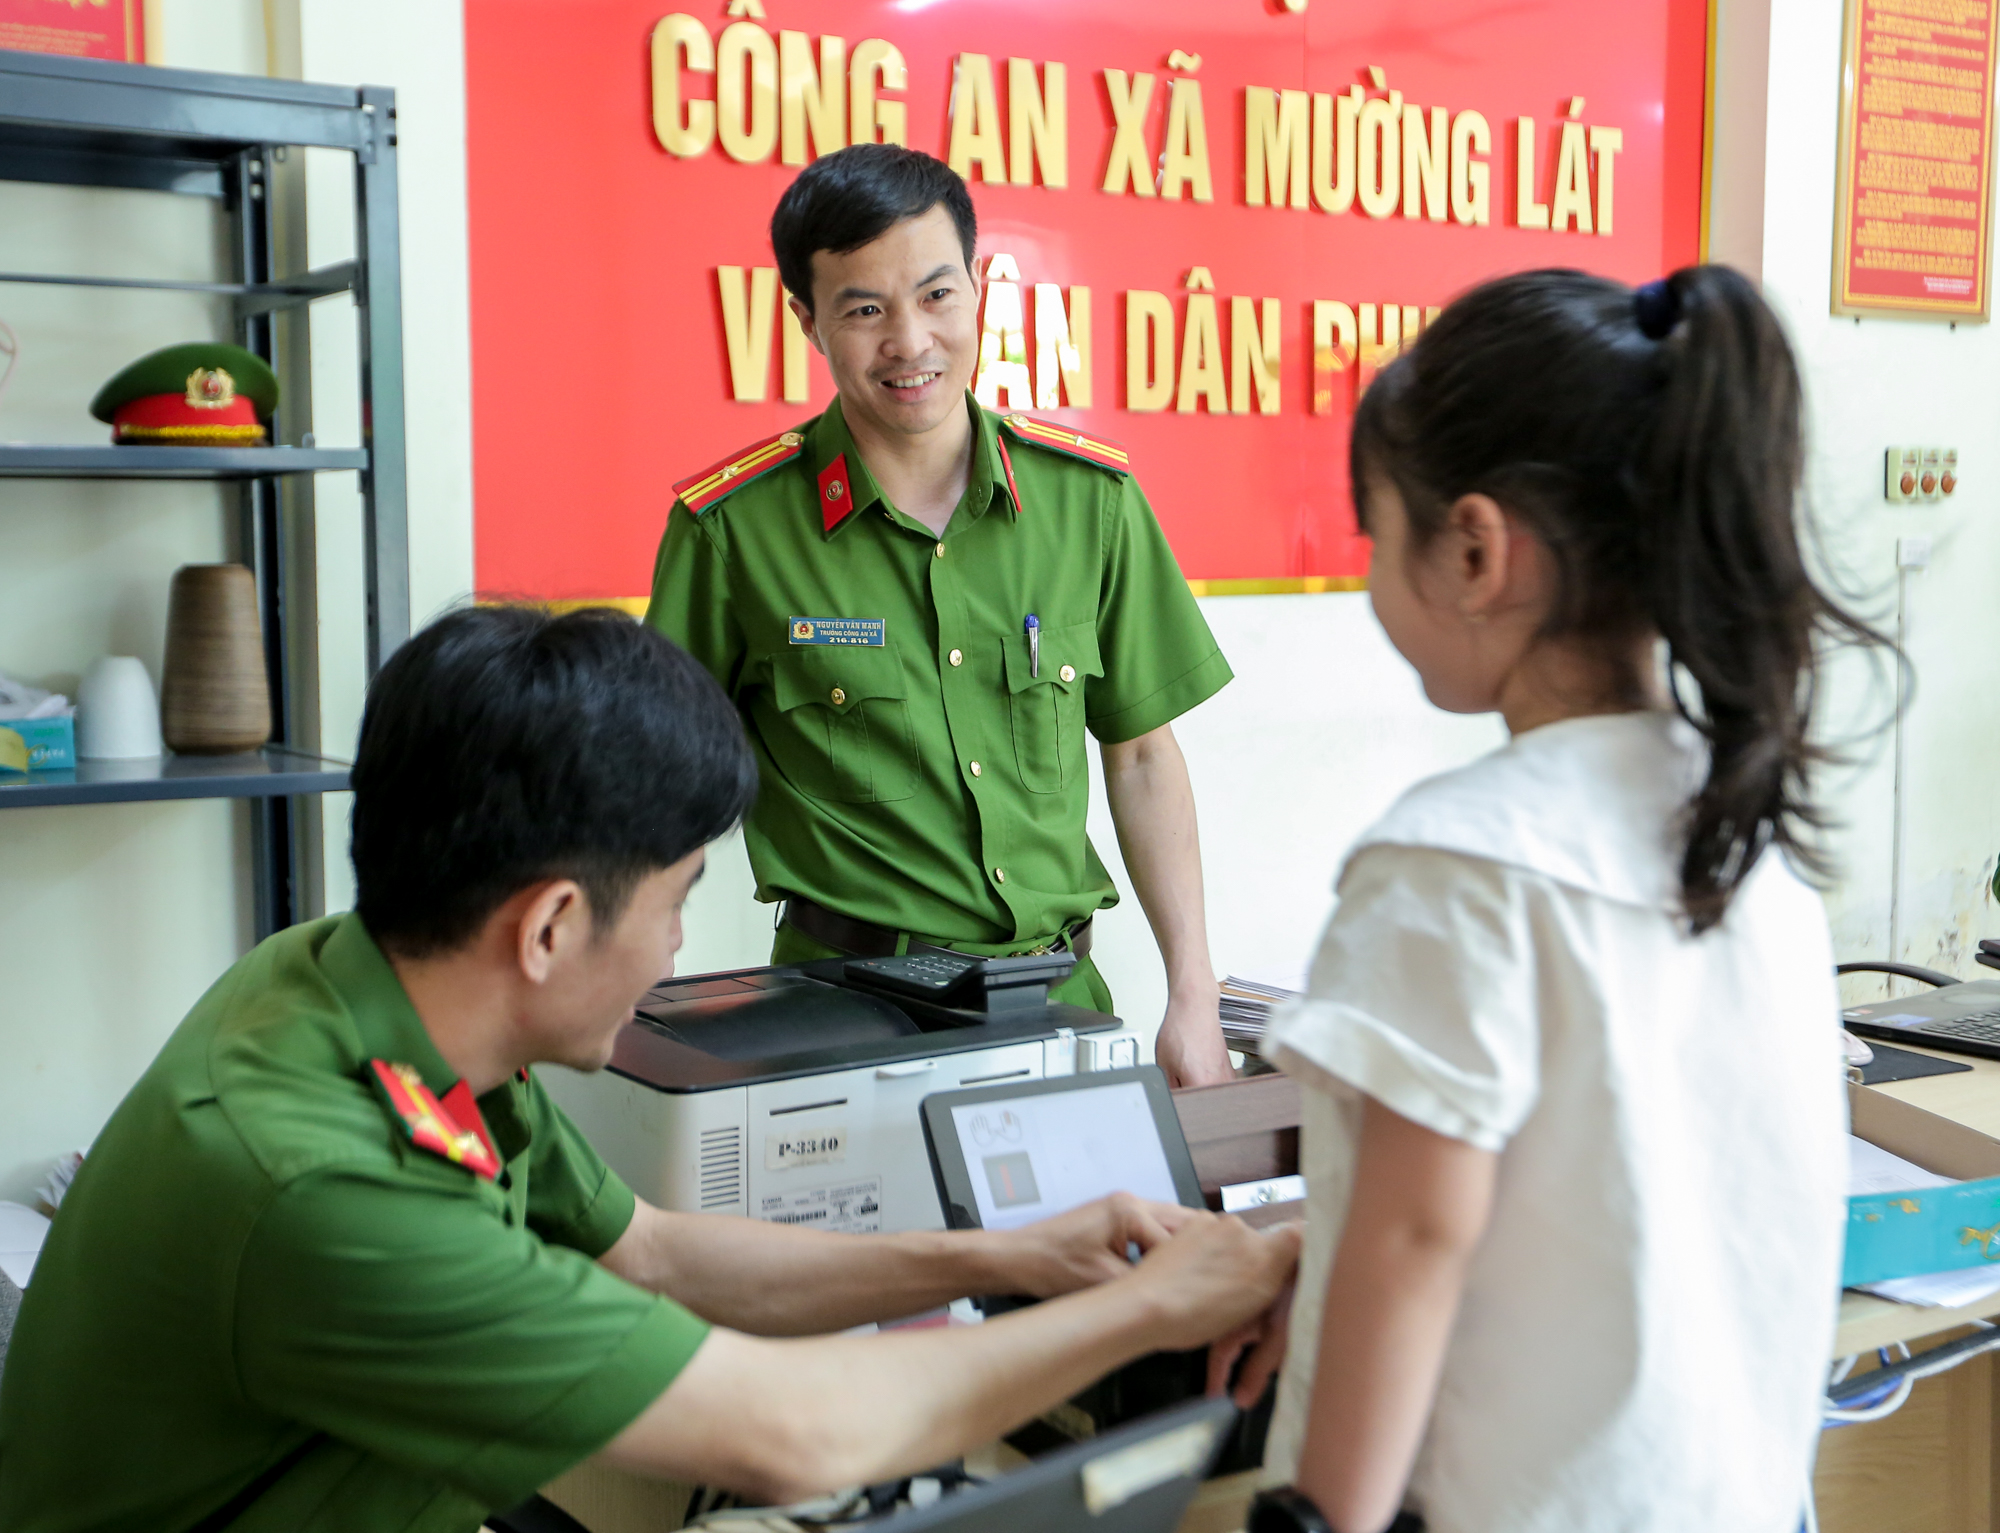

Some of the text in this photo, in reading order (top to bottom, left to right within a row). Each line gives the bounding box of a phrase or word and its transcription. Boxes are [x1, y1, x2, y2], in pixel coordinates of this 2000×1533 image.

[651, 0, 1623, 236] CÔNG AN XÃ MƯỜNG LÁT
[973, 253, 1092, 410] ÂN
[1126, 266, 1281, 416] DÂN
